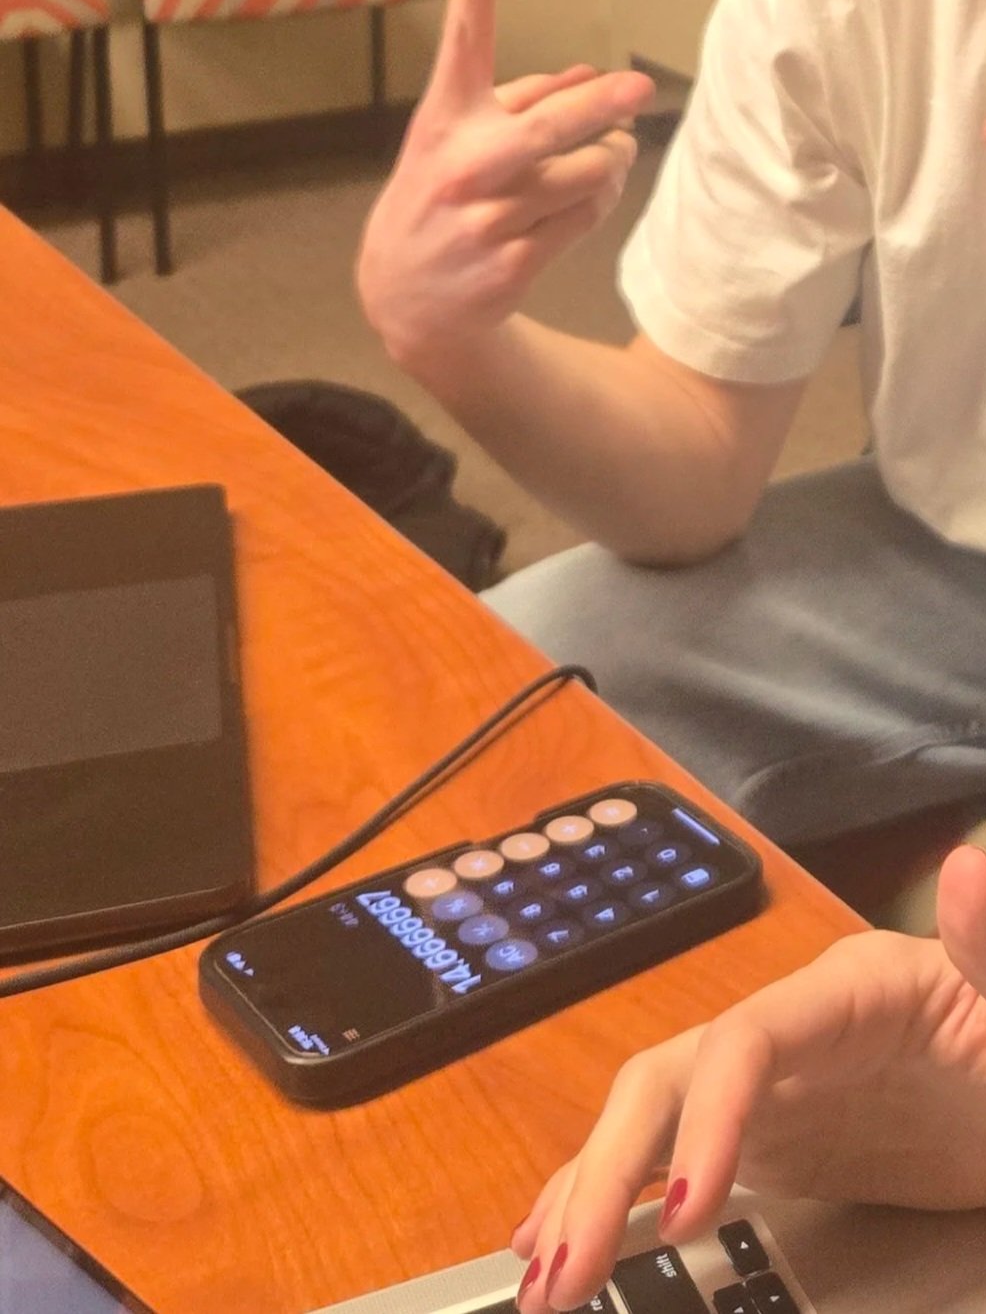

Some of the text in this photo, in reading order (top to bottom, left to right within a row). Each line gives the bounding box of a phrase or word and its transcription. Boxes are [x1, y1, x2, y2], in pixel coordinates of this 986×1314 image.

[356, 890, 481, 993] 14.6666667
[547, 929, 570, 943] 7
[499, 943, 524, 963] AC
[656, 1253, 677, 1278] shift
